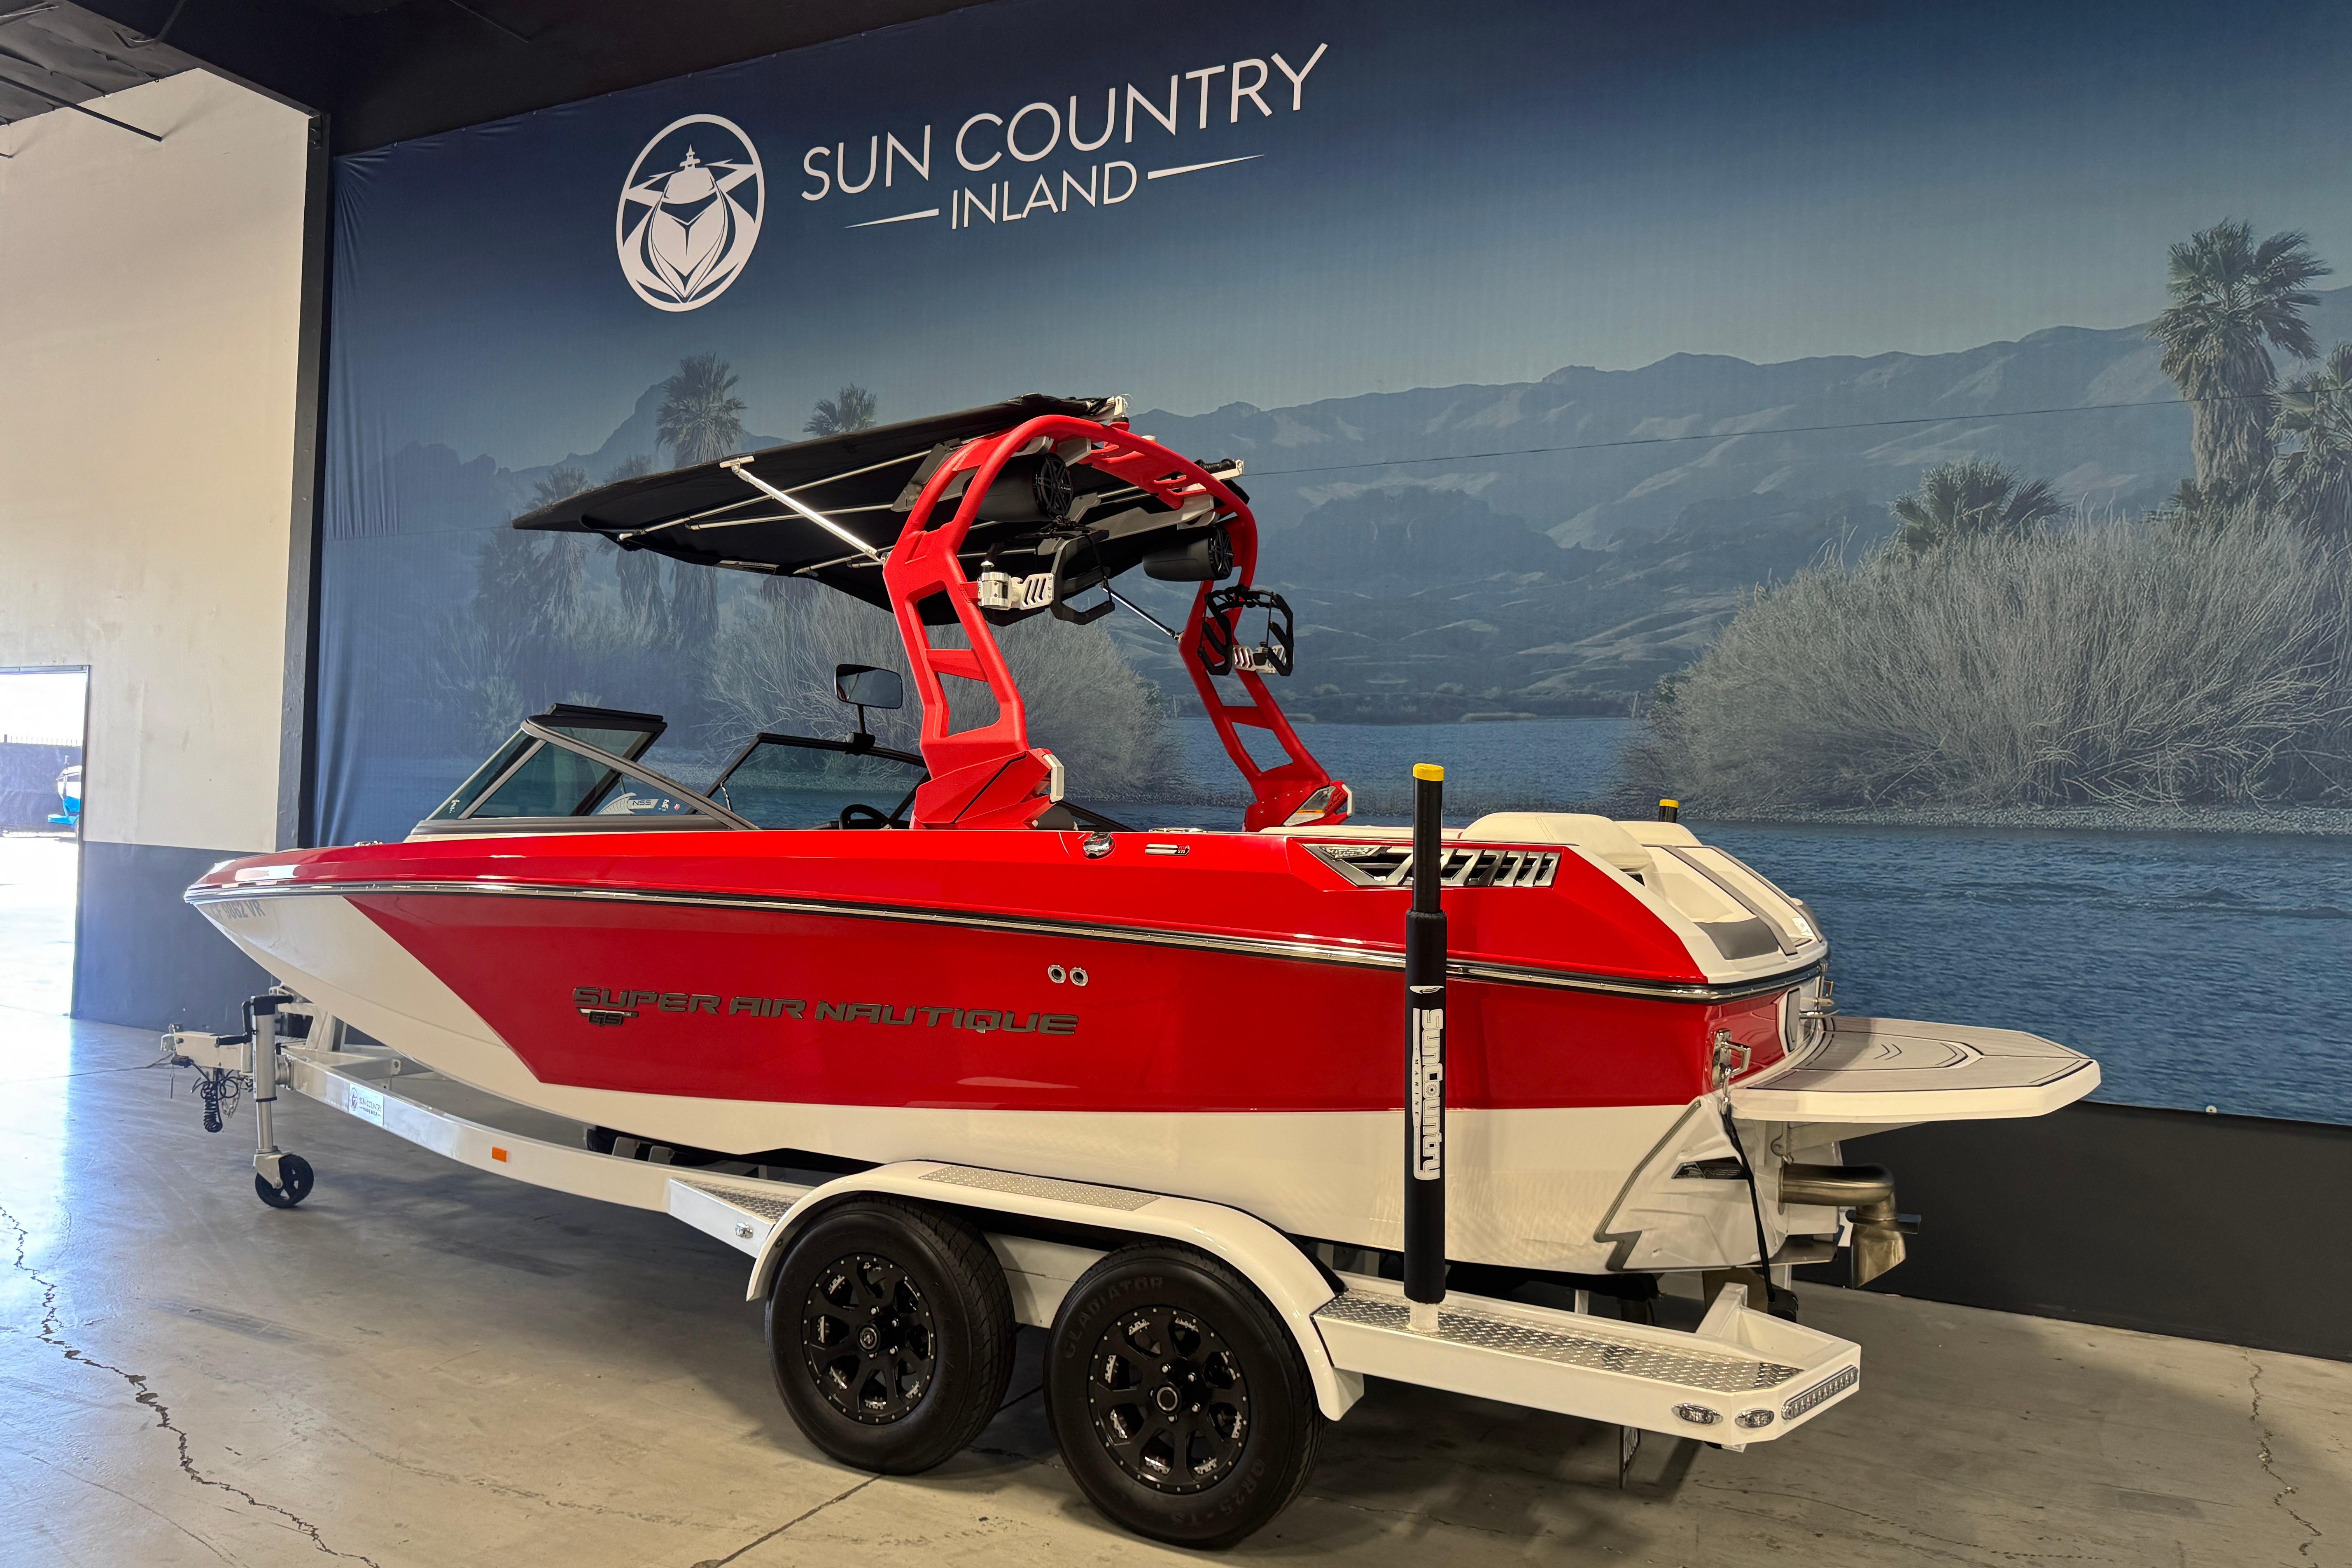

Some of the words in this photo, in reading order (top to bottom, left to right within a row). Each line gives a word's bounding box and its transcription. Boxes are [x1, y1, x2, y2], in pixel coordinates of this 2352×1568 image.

[800, 124, 931, 201] SUN
[955, 42, 1329, 172] COUNTRY
[951, 161, 1138, 230] INLAND
[243, 899, 266, 917] VR
[573, 987, 721, 1015] SUPER
[729, 995, 807, 1020] AIR
[815, 1001, 1079, 1035] NAUTIQUE
[1065, 1276, 1163, 1359] GLADIATOR
